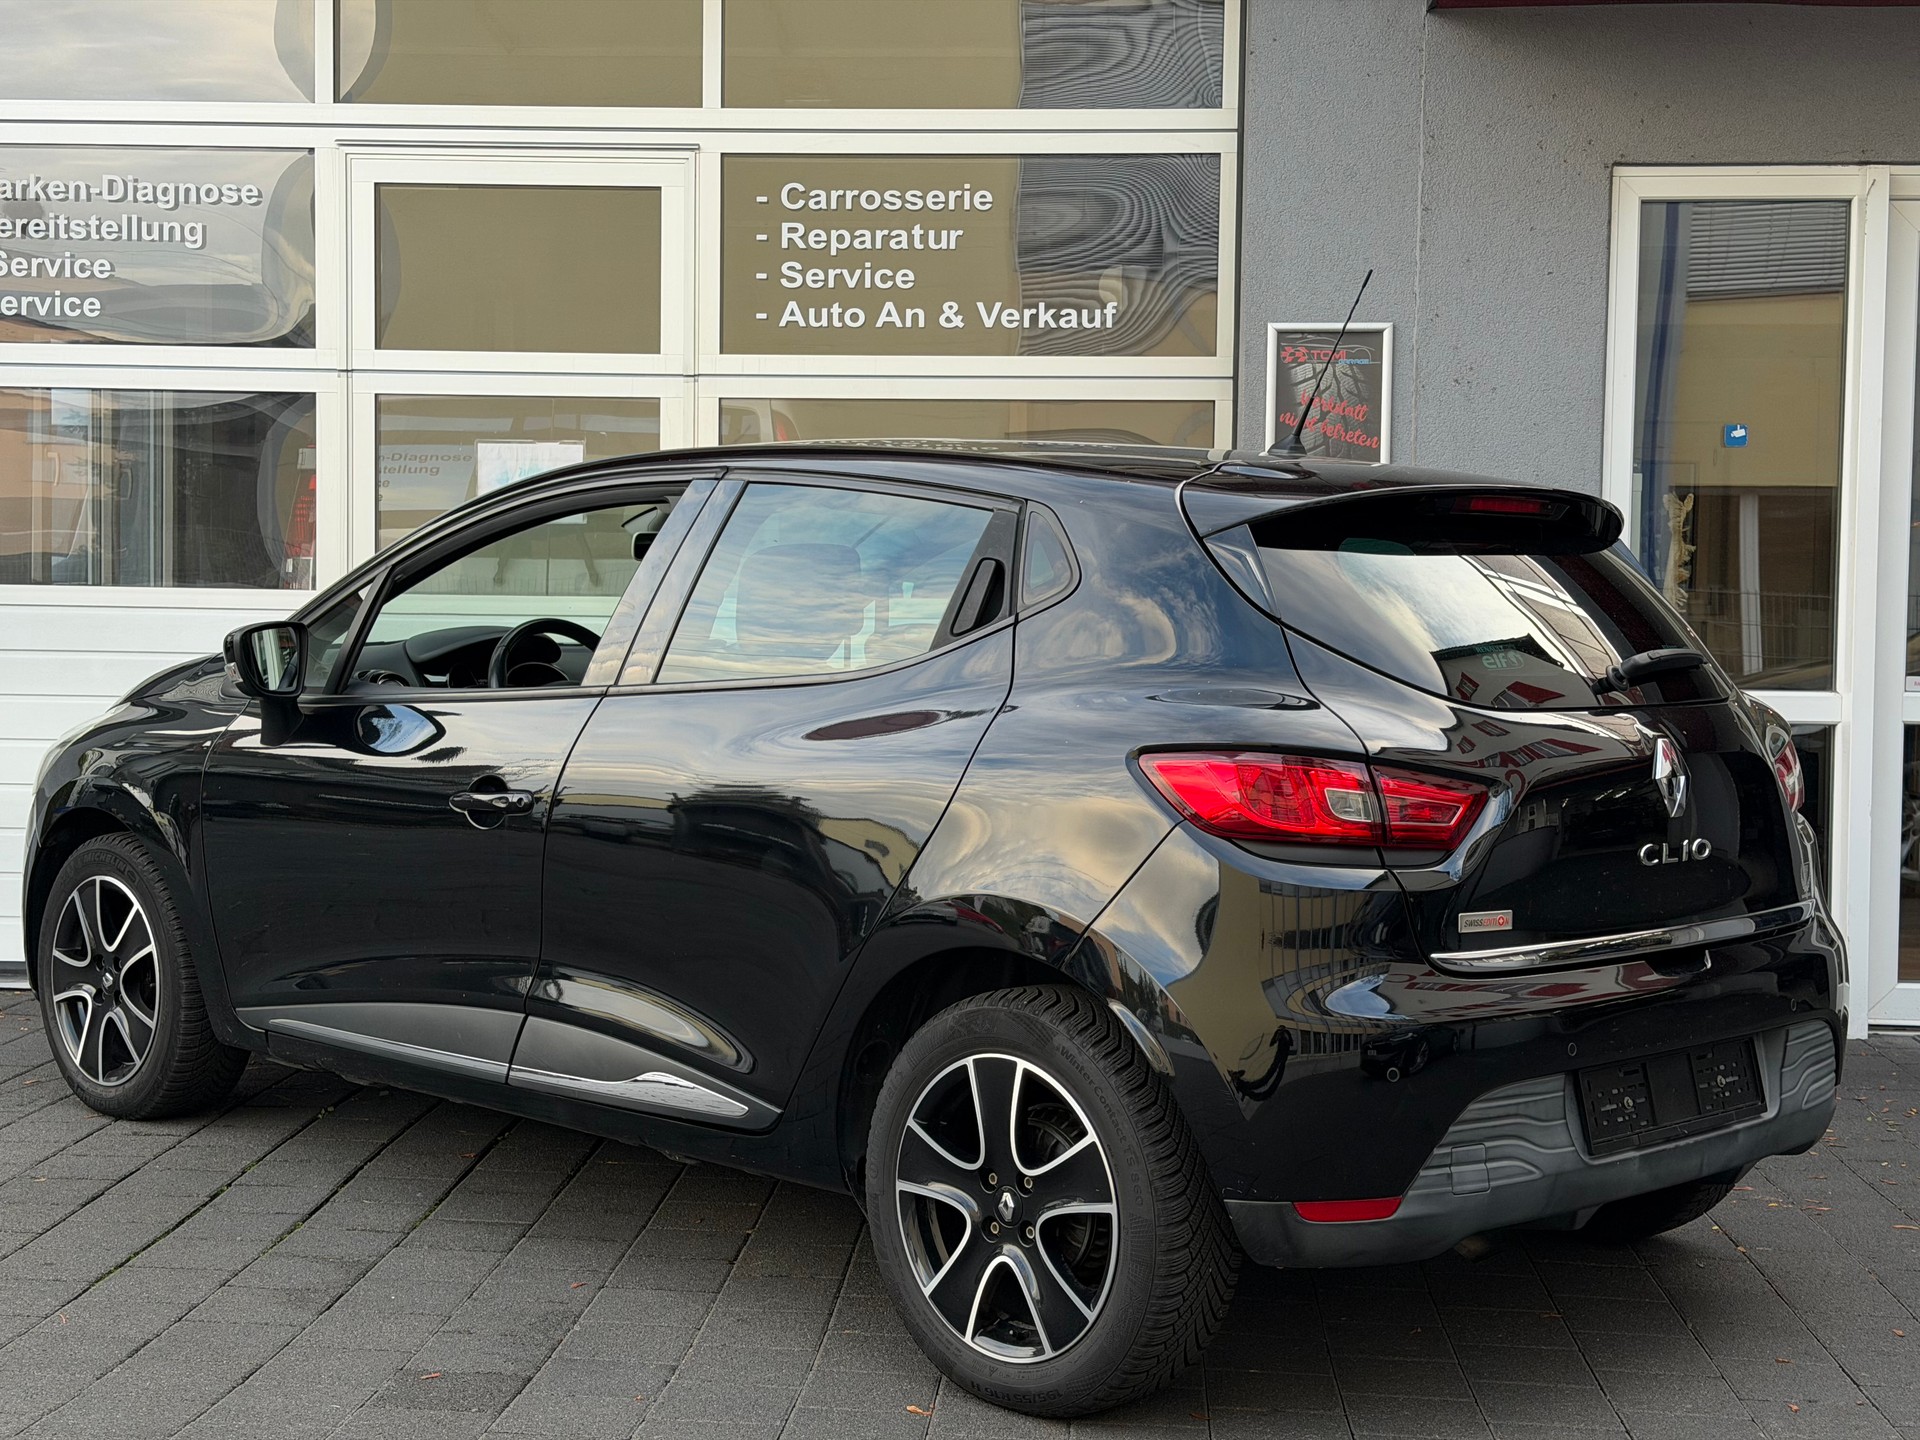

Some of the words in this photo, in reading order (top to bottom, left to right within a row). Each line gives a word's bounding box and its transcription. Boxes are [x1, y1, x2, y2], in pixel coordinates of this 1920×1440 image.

[780, 182, 993, 210] Carrosserie
[781, 222, 963, 256] Reparatur
[780, 261, 915, 289] Service
[779, 301, 866, 328] Auto
[876, 301, 925, 328] An
[938, 302, 965, 328] &
[977, 301, 1118, 328] Verkauf
[1482, 653, 1508, 668] elf
[1638, 838, 1712, 867] CLIO
